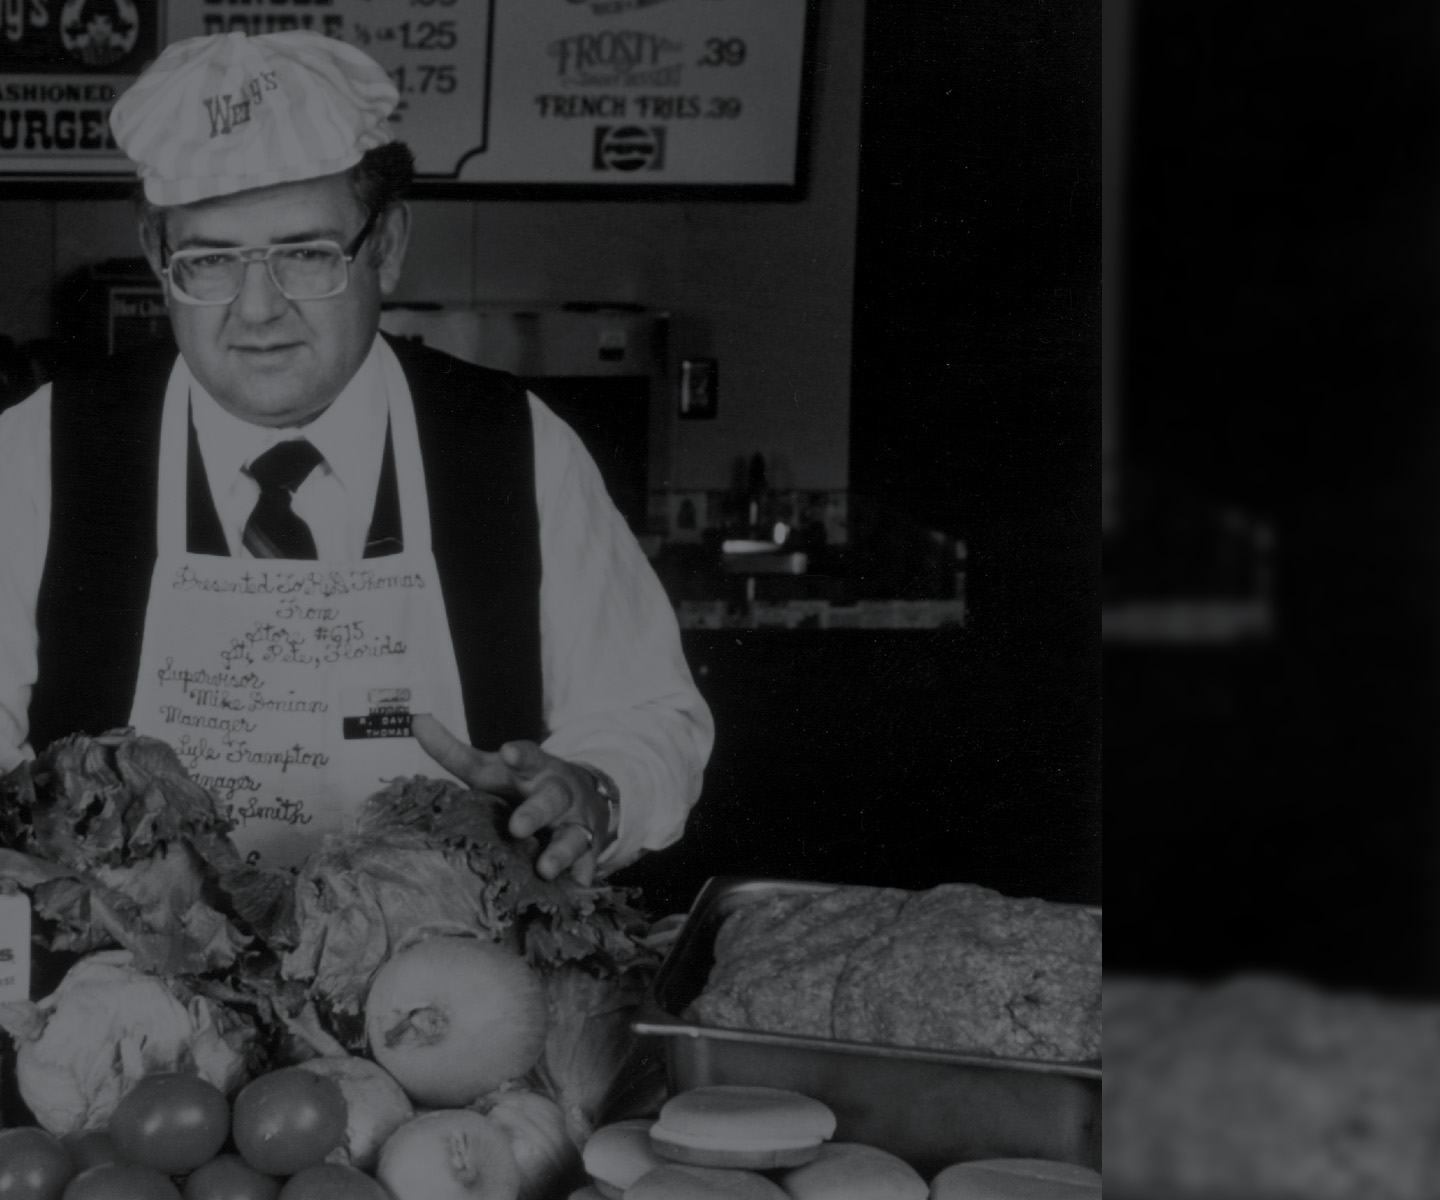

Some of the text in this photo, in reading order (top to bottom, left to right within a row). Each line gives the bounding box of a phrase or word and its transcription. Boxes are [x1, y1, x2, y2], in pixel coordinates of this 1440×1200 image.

[698, 37, 747, 67] .39
[394, 65, 458, 95] 1.75
[535, 95, 627, 118] FRENCH
[635, 95, 702, 118] FRIES
[171, 563, 275, 594] Presented
[350, 569, 426, 591] Thomas
[275, 598, 339, 621] From
[246, 620, 366, 647] Store #615
[324, 636, 408, 664] Florida
[157, 655, 266, 693] Supervisor
[189, 687, 246, 712] Mike
[159, 704, 257, 745] Manager
[366, 727, 410, 737] THOMAS
[381, 716, 411, 726] DAVI
[226, 740, 330, 773] Frampton
[188, 772, 262, 800] anager
[237, 796, 313, 828] Smith
